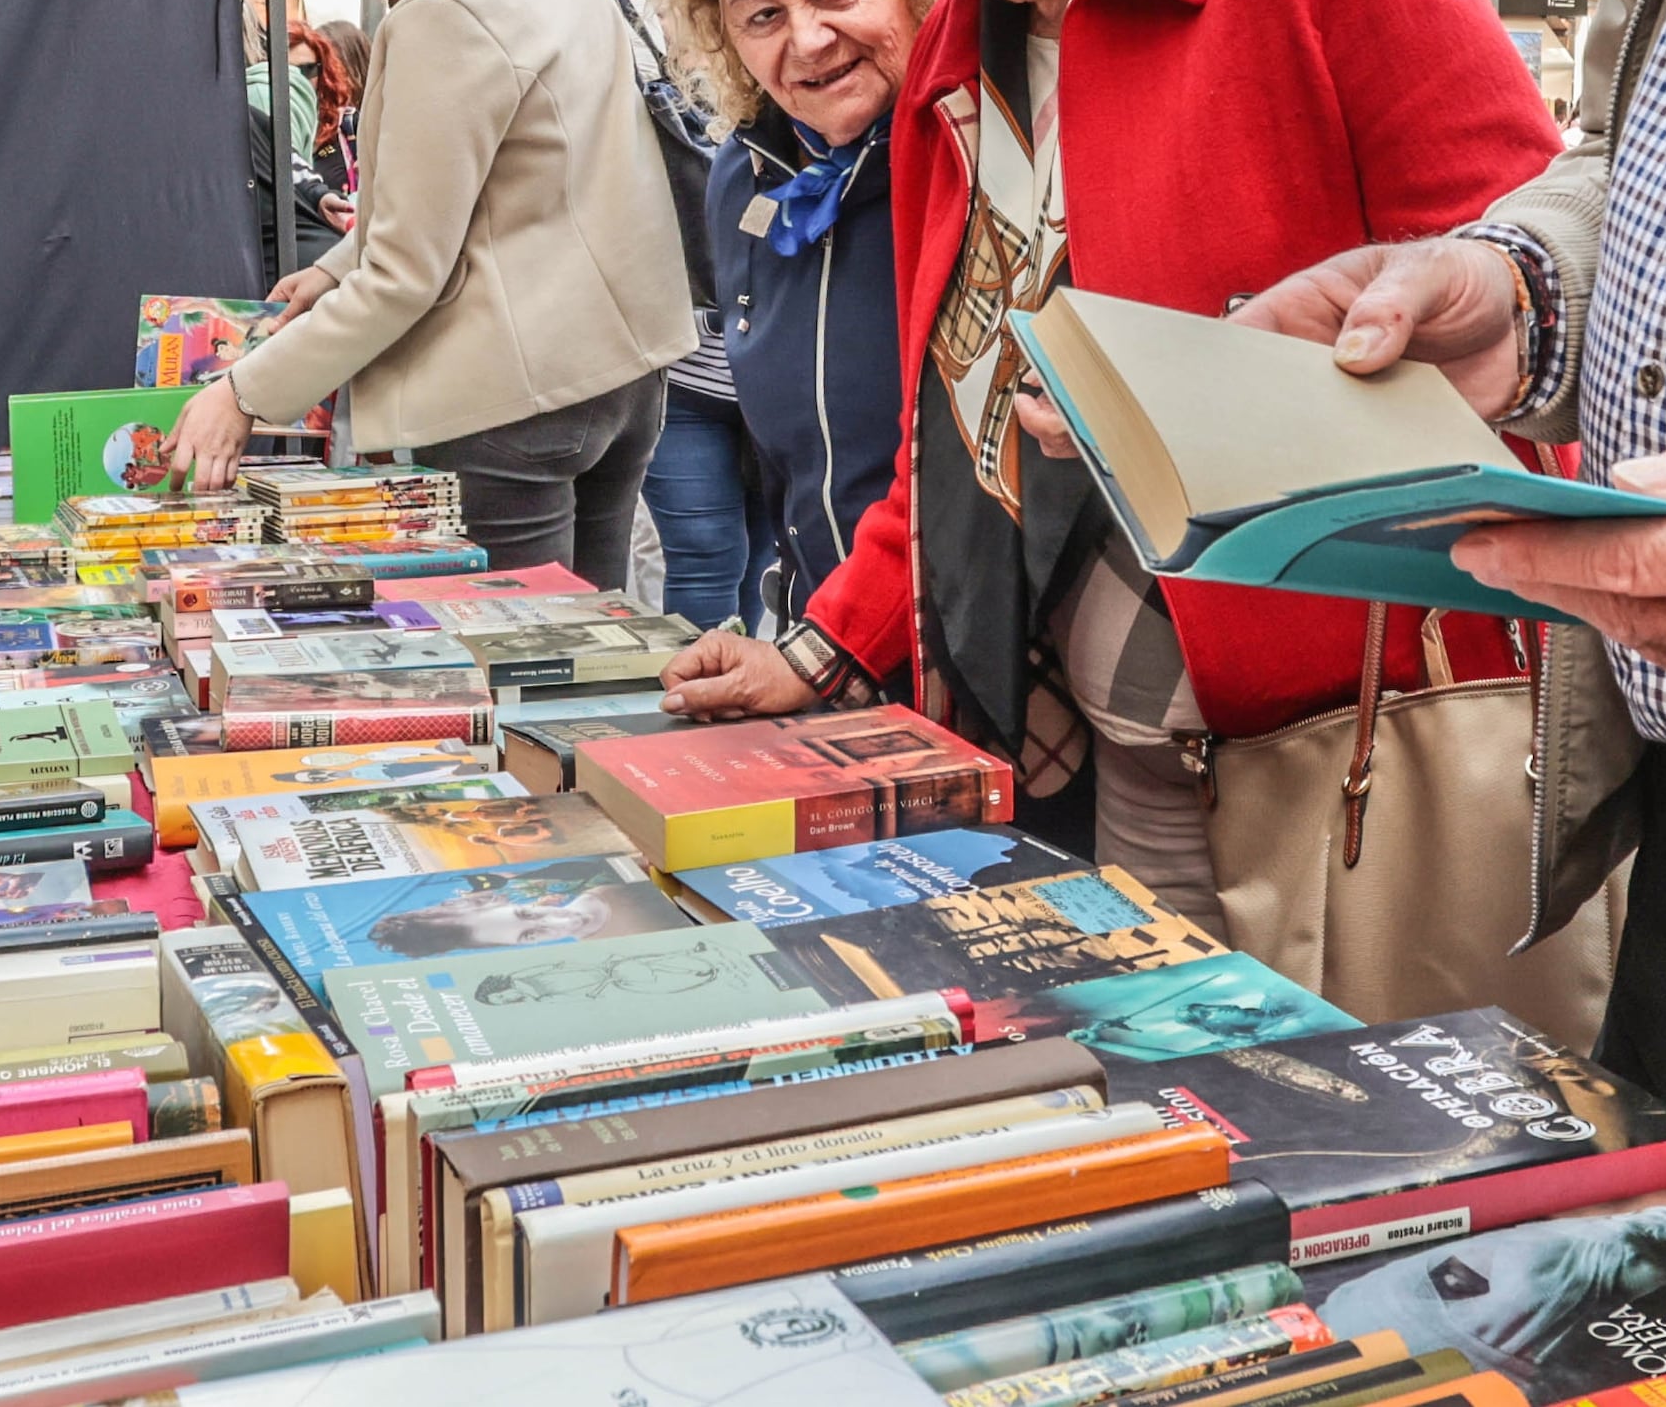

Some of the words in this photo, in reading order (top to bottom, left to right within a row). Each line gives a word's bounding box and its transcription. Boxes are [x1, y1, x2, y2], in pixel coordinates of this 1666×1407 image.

[162, 337, 179, 386] MULAN
[206, 588, 247, 598] DEBORAH
[206, 597, 247, 607] SIMMONS
[30, 764, 70, 775] ALTALENA
[828, 804, 874, 819] CÓDIGO
[900, 796, 935, 810] VINCI
[809, 825, 826, 835] Dan
[829, 821, 855, 834] Brown
[13, 852, 26, 864] El
[290, 819, 351, 880] MEMORIAS
[876, 842, 981, 895] Compostela
[724, 867, 814, 917] Coelho
[382, 976, 420, 991] el
[347, 980, 390, 1027] Chacel
[392, 992, 441, 1035] Desde
[439, 991, 494, 1057] amanecer
[385, 1034, 411, 1069] Rosa
[15, 1061, 89, 1080] HOMBRE
[93, 1057, 112, 1070] EL
[1349, 1042, 1494, 1128] OPERACIÓN
[1390, 1023, 1597, 1142] COBRA
[637, 1166, 665, 1180] La
[671, 1160, 717, 1176] cruz
[723, 1157, 734, 1170] y
[740, 1147, 763, 1162] el
[765, 1142, 806, 1159] lirio
[812, 1128, 884, 1150] dorado
[52, 1212, 88, 1231] del
[1049, 1221, 1092, 1239] Mary
[1388, 1222, 1424, 1240] Preston
[1429, 1216, 1464, 1233] Richard
[977, 1229, 1047, 1256] Higgins
[1304, 1233, 1370, 1260] OPERACIÓN
[923, 1246, 974, 1262] Clark
[164, 1337, 236, 1357] personales
